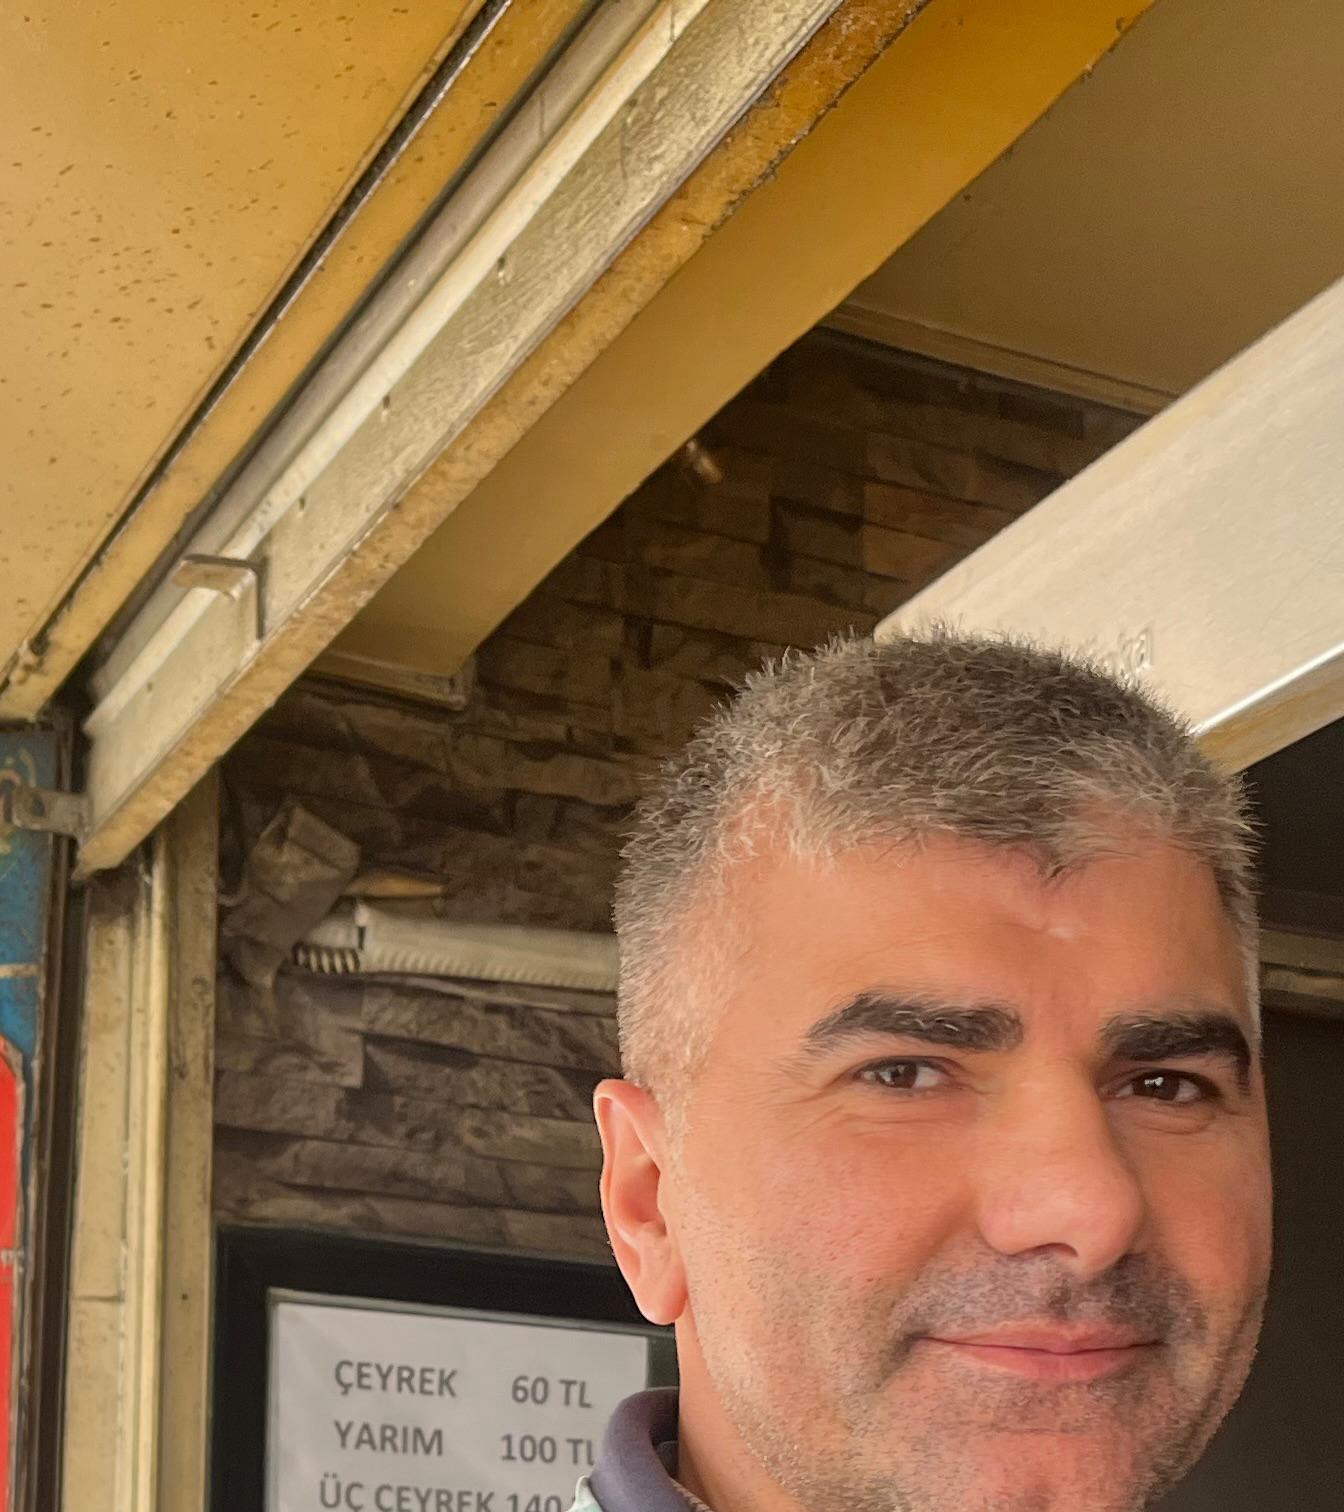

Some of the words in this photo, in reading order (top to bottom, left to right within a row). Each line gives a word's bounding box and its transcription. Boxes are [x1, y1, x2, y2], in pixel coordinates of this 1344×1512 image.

[334, 1359, 457, 1398] ÇEYREK
[511, 1375, 549, 1405] 60
[559, 1379, 593, 1409] TL
[333, 1419, 444, 1456] YARIM
[500, 1433, 557, 1464] 100
